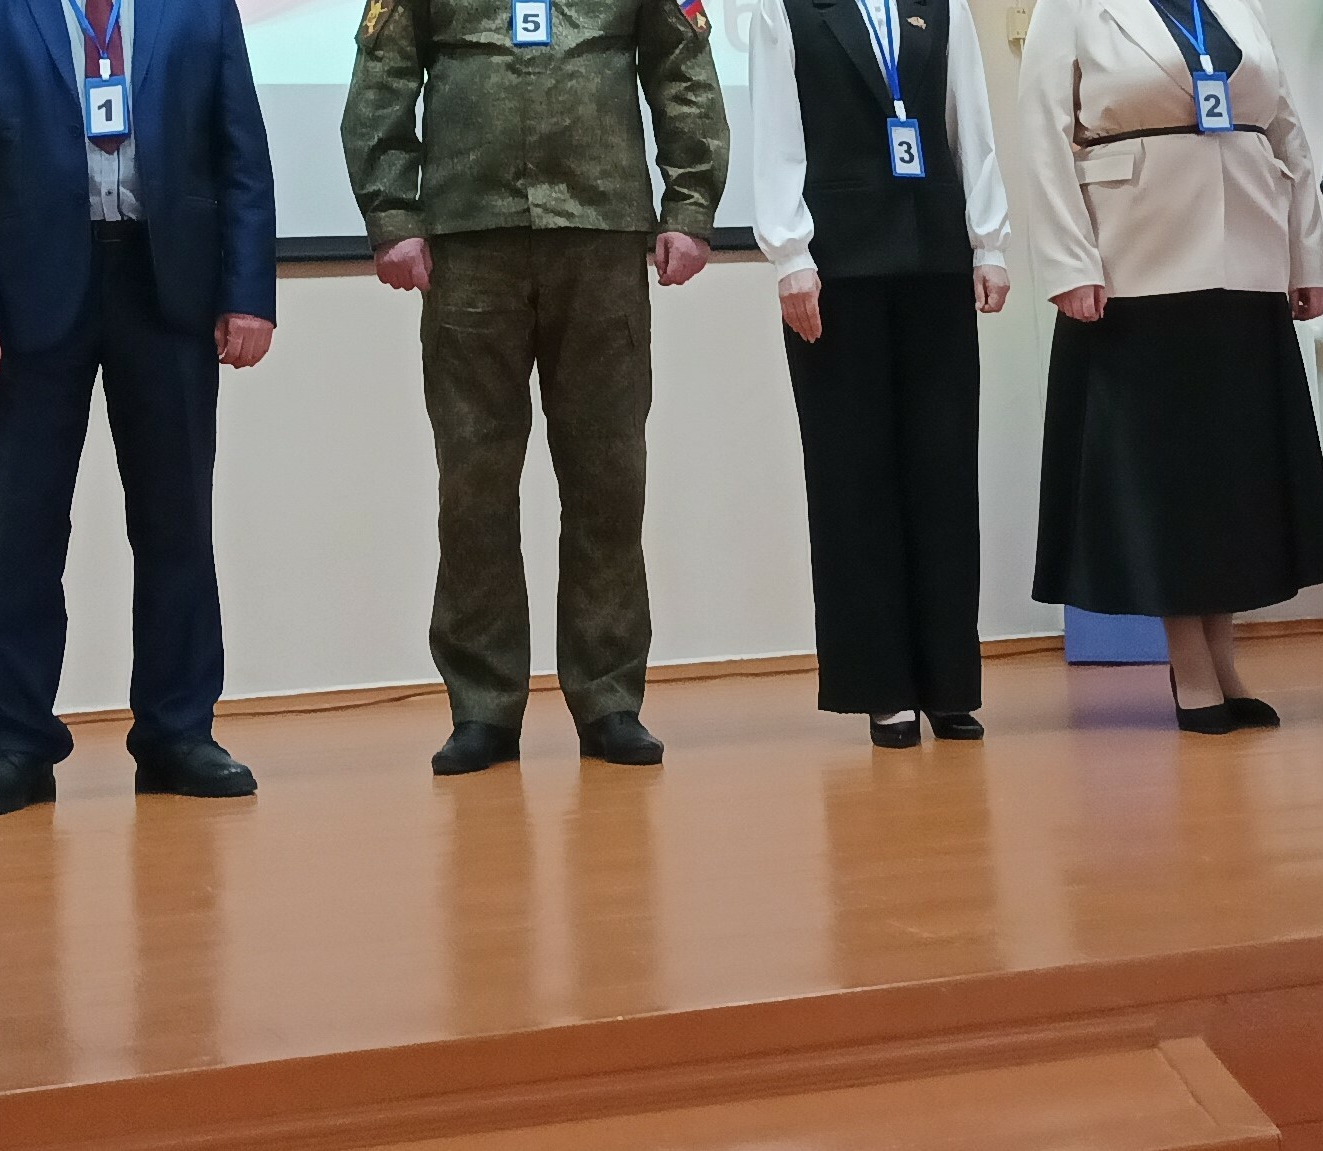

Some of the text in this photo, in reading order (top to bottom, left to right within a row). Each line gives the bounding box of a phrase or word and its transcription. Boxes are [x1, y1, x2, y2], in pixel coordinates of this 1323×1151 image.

[521, 13, 542, 33] 5
[97, 99, 113, 122] 1
[1203, 94, 1224, 118] 2
[897, 141, 916, 165] 3
